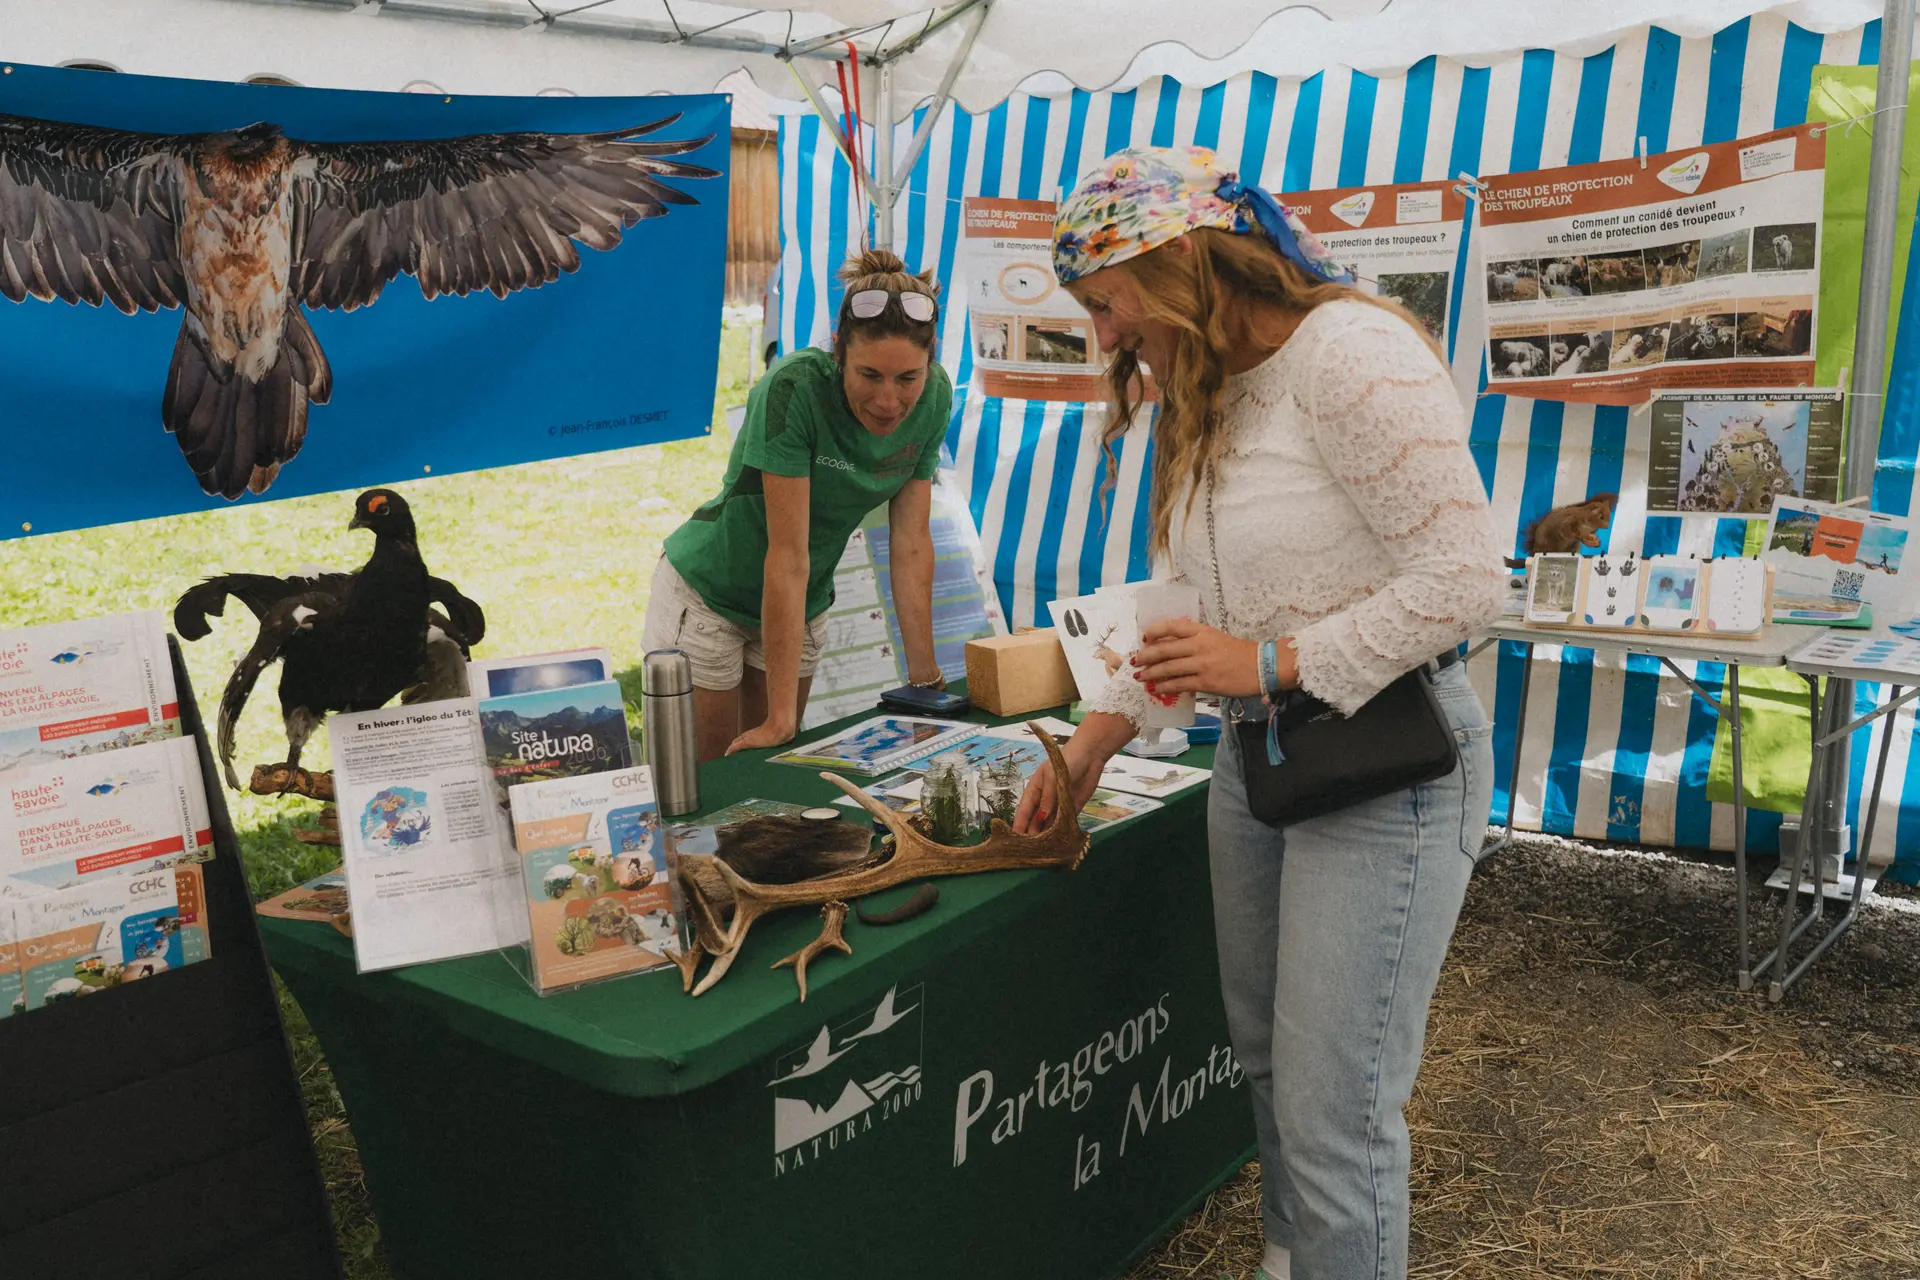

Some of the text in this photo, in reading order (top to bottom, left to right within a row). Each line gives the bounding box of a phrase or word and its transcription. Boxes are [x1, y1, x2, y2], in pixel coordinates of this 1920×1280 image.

[1484, 174, 1634, 201] LE CHIEN DE PROTECTION
[991, 210, 1003, 219] DE
[1484, 194, 1573, 212] DES TROUPEAUX
[1572, 200, 1717, 229] Comment un canidé devient
[1547, 235, 1559, 244] un
[1561, 231, 1587, 242] chien
[1590, 228, 1603, 239] de
[1606, 223, 1657, 240] protection
[1660, 220, 1679, 232] des
[1682, 209, 1736, 227] troupeaux
[1331, 236, 1373, 250] protection
[1374, 234, 1390, 246] des
[1392, 233, 1437, 246] troupeaux
[560, 416, 627, 437] Jean-François
[629, 410, 669, 426] DESMET
[16, 697, 37, 707] LES
[39, 687, 86, 702] ALPAGES
[143, 657, 160, 723] ENVIRONNEMENT
[358, 722, 371, 731] En
[406, 715, 437, 726] l'igloo
[440, 711, 453, 721] du
[511, 730, 539, 745] Site
[11, 783, 53, 801] haute
[14, 792, 60, 812] savoie
[18, 817, 81, 839] BIENVENUE
[178, 785, 195, 849] ENVIRONNEMENT
[20, 833, 51, 848] DANS
[53, 829, 74, 842] LES
[75, 817, 122, 836] ALPAGES
[21, 845, 34, 857] DE
[35, 842, 51, 853] LA
[953, 992, 1171, 1168] Partageons
[774, 1083, 923, 1178] NATURA 2000
[1073, 1132, 1101, 1192] la
